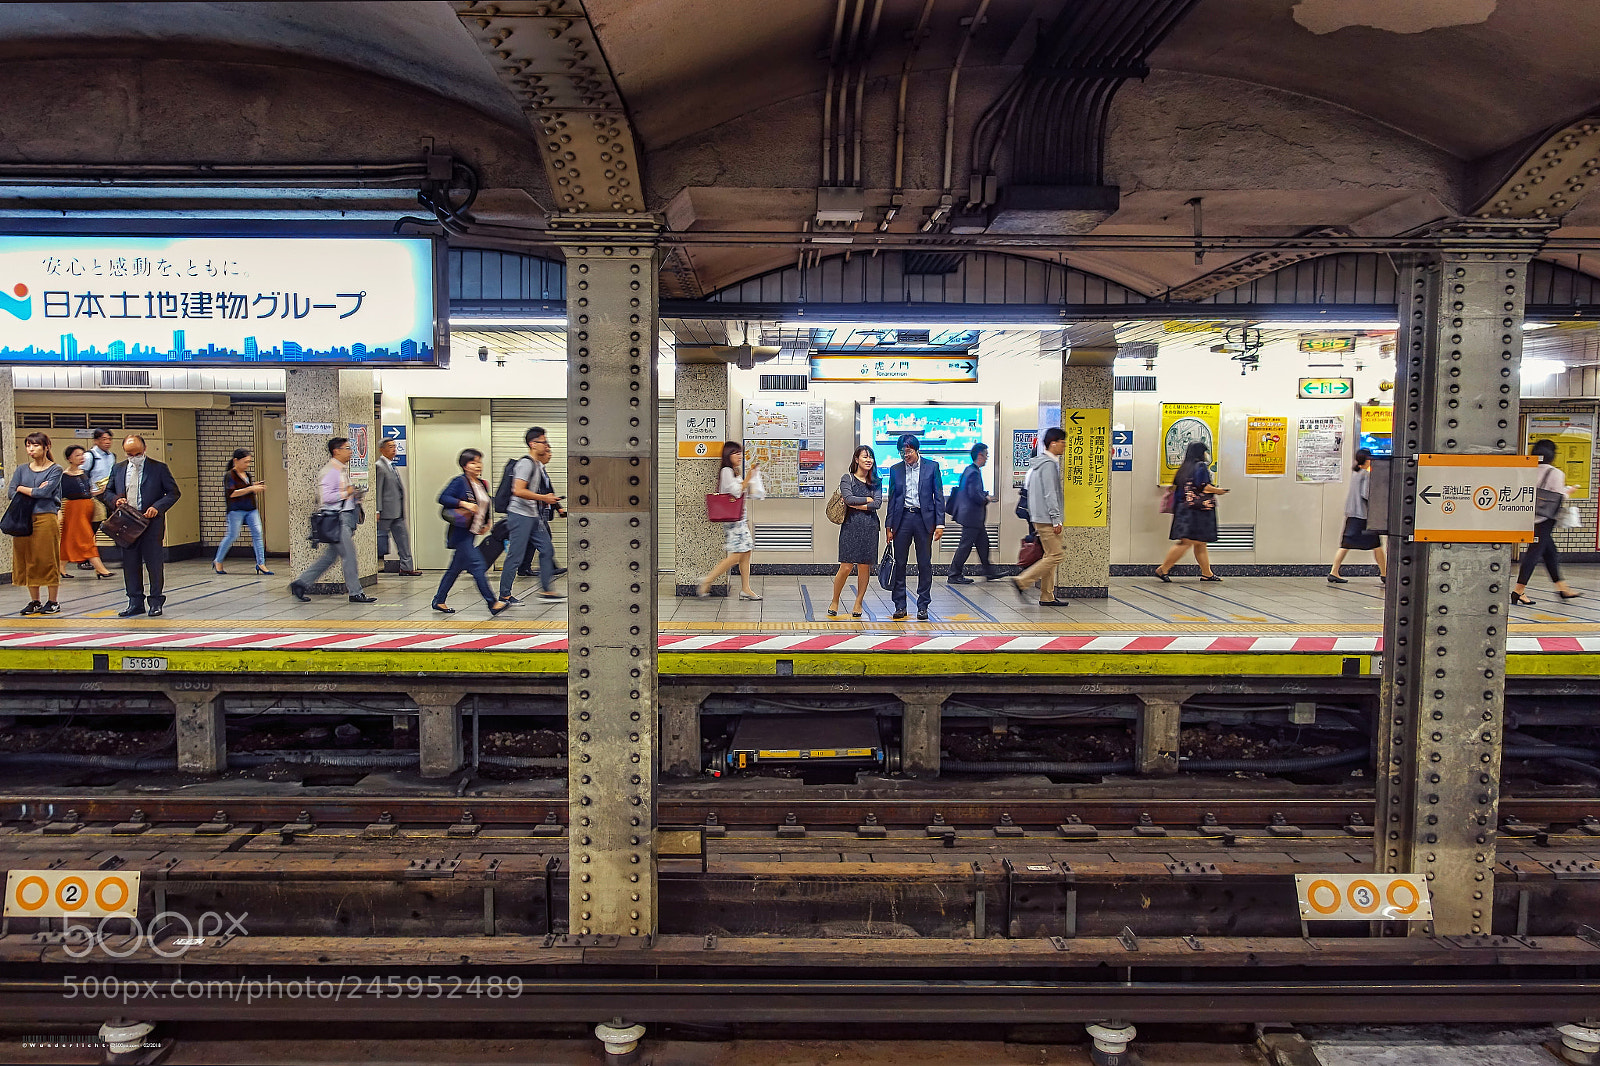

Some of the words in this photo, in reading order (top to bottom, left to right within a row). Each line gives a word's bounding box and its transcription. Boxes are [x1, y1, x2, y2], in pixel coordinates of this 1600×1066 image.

[42, 256, 250, 278] 安心と感動を、ともに。
[43, 290, 367, 319] 日本土地建物グループ
[874, 361, 910, 371] 虎ノ門
[686, 417, 716, 428] 虎ノ門
[1076, 426, 1083, 435] 3
[1097, 426, 1106, 435] 11
[1073, 435, 1084, 486] 虎の門病院
[1442, 485, 1472, 496] 溜池山王
[1482, 488, 1490, 496] G
[1498, 486, 1535, 503] 虎ノ門
[1478, 496, 1493, 506] 07
[1498, 503, 1534, 512] Toranomon
[65, 885, 78, 902] 2
[1357, 888, 1370, 905] 3
